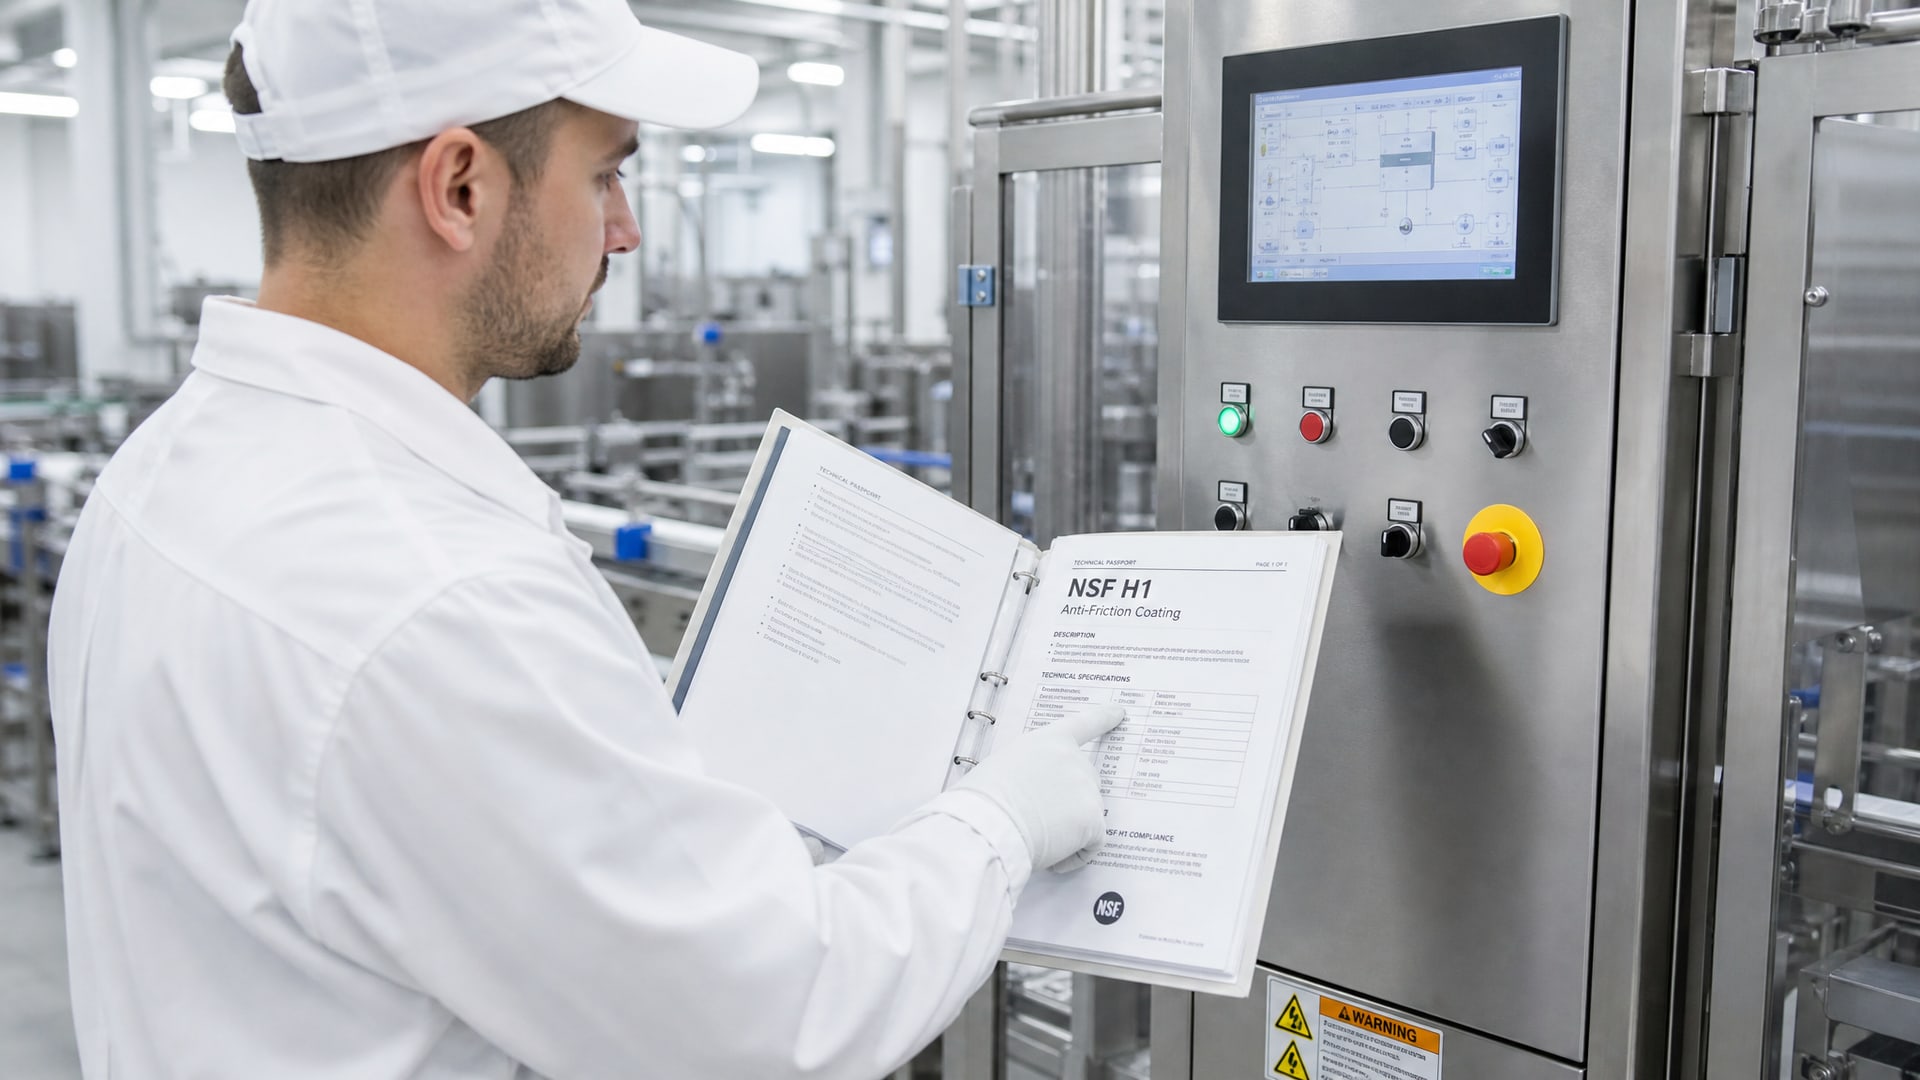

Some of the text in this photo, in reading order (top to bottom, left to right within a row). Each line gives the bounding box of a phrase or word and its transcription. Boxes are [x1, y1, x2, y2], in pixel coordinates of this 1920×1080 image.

[1068, 578, 1152, 599] NSF H1
[1060, 604, 1181, 621] Anti-Friction Coating
[1053, 631, 1096, 639] DESCRIPTION
[1041, 671, 1132, 683] TECHNICAL SPECIFICATIONS
[1129, 831, 1175, 842] COMPLIANCE
[1352, 1009, 1418, 1043] WARNING
